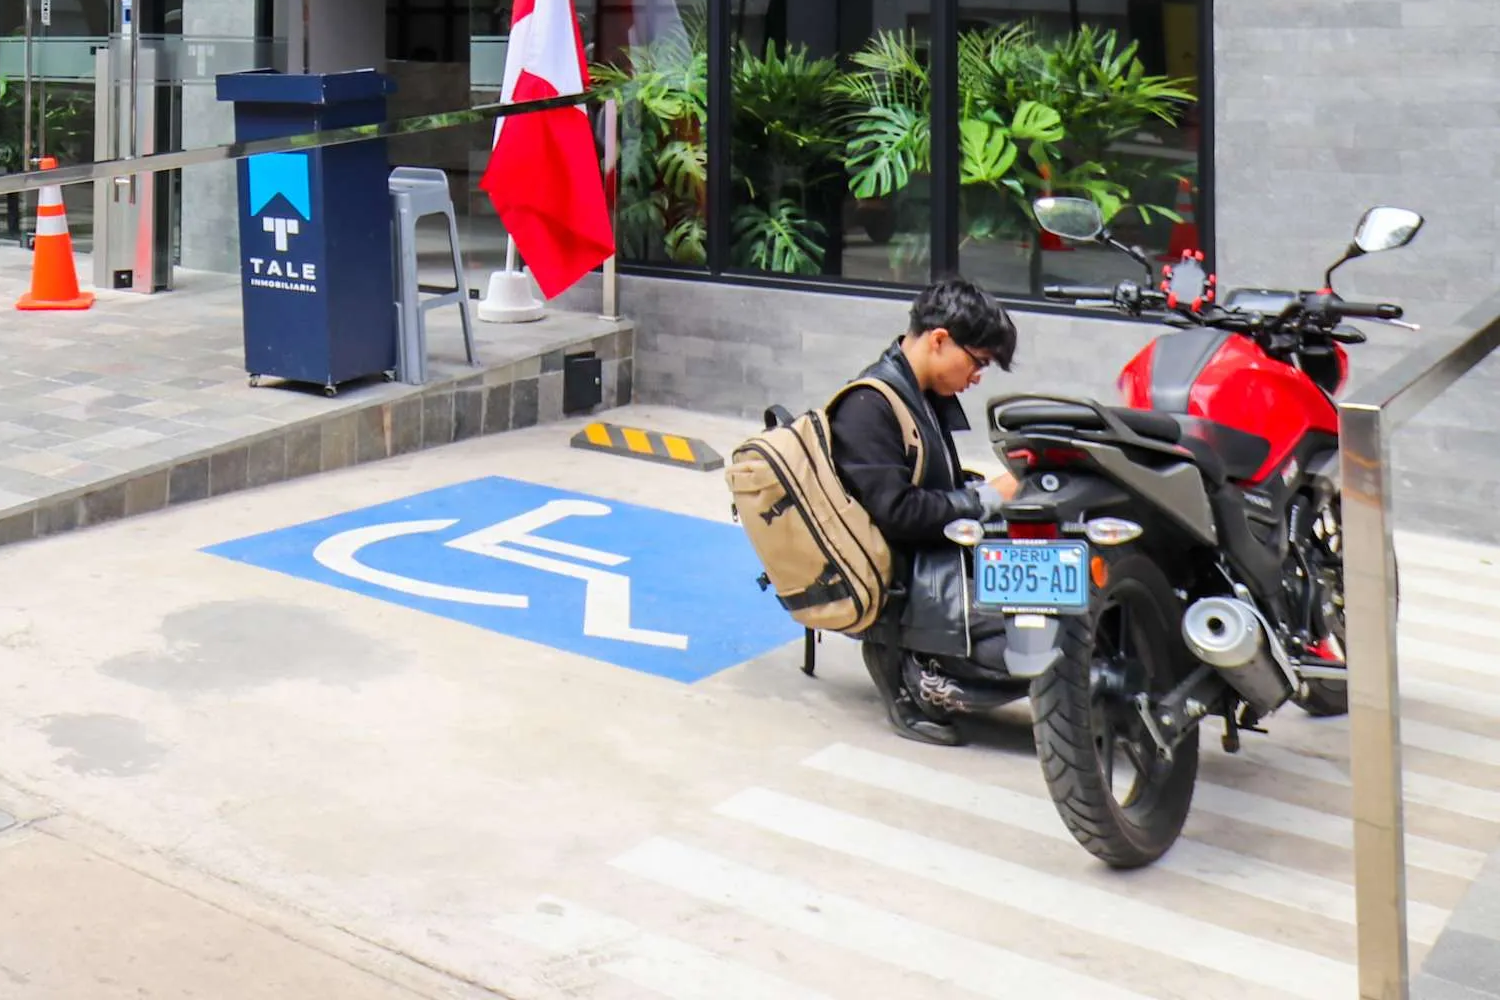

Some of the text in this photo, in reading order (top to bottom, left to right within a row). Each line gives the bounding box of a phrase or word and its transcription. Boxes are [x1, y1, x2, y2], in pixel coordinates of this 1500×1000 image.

[250, 257, 316, 280] TALE
[250, 278, 317, 293] INMOBILIARIA
[1009, 549, 1051, 562] PERU
[984, 564, 1077, 593] 0395-AD
